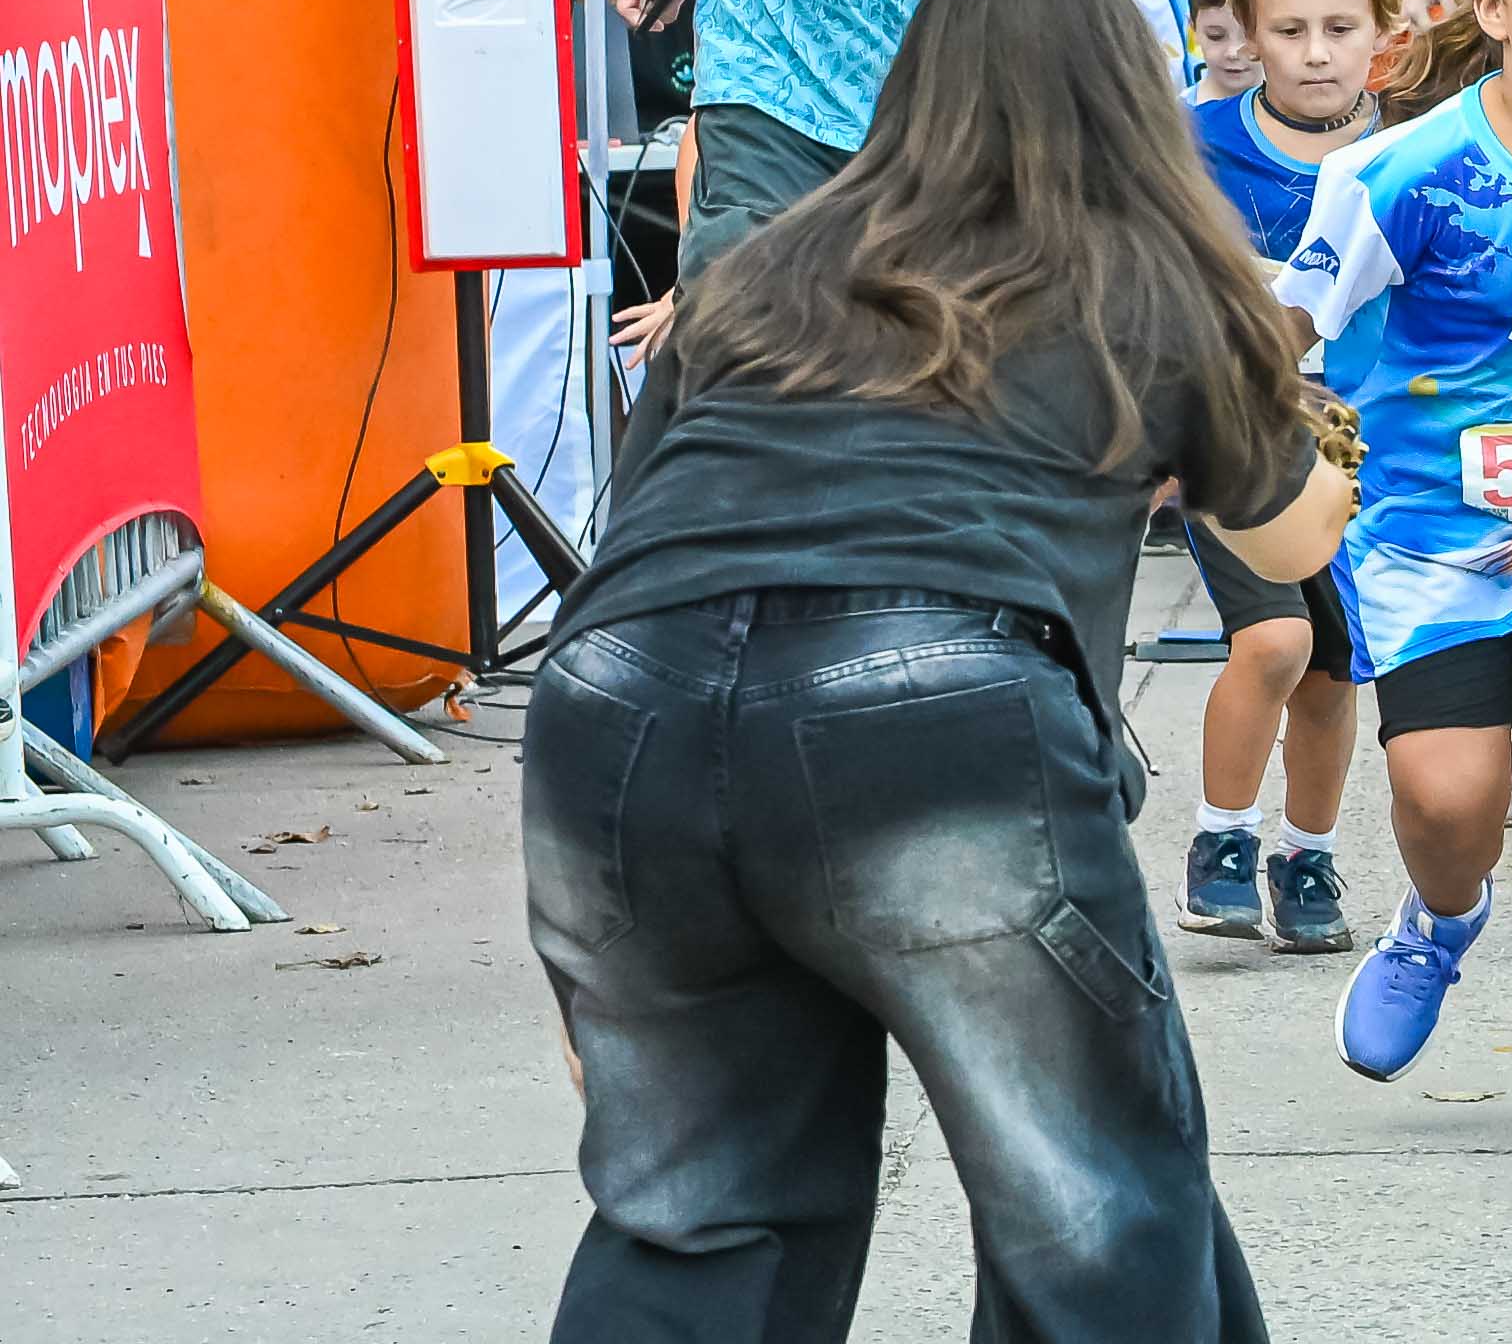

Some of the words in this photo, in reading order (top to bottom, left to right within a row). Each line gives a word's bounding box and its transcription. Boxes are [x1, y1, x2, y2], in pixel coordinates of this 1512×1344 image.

[21, 360, 93, 471] TECNOLOGIA
[96, 351, 112, 397] EN
[113, 343, 136, 389] TUS
[140, 341, 168, 387] PIES
